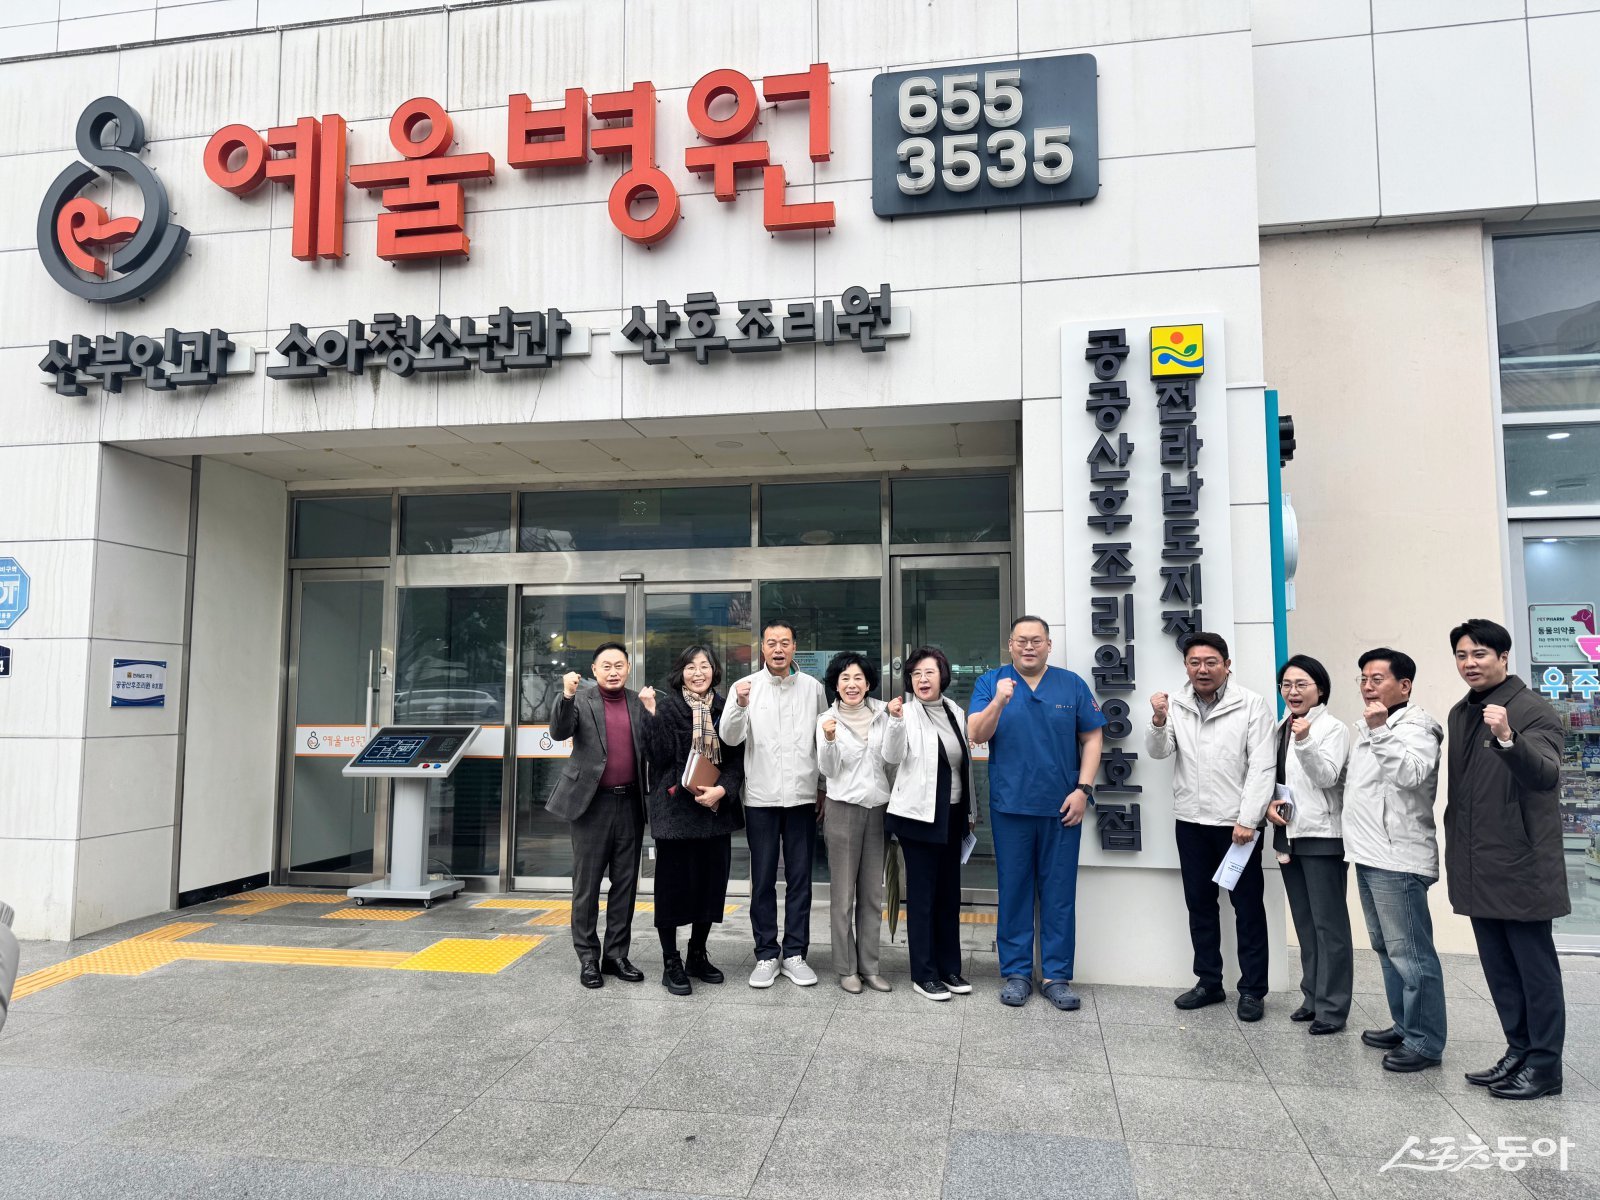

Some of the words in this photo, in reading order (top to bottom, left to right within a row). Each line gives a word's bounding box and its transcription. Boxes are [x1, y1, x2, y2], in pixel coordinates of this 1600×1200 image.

[898, 68, 1024, 135] 655
[203, 62, 835, 263] 예울병원
[896, 125, 1074, 196] 3535
[38, 328, 236, 396] 산부인과
[266, 306, 572, 380] 소아청소년과
[621, 283, 892, 365] 산후조리원
[323, 735, 366, 748] 예울병원
